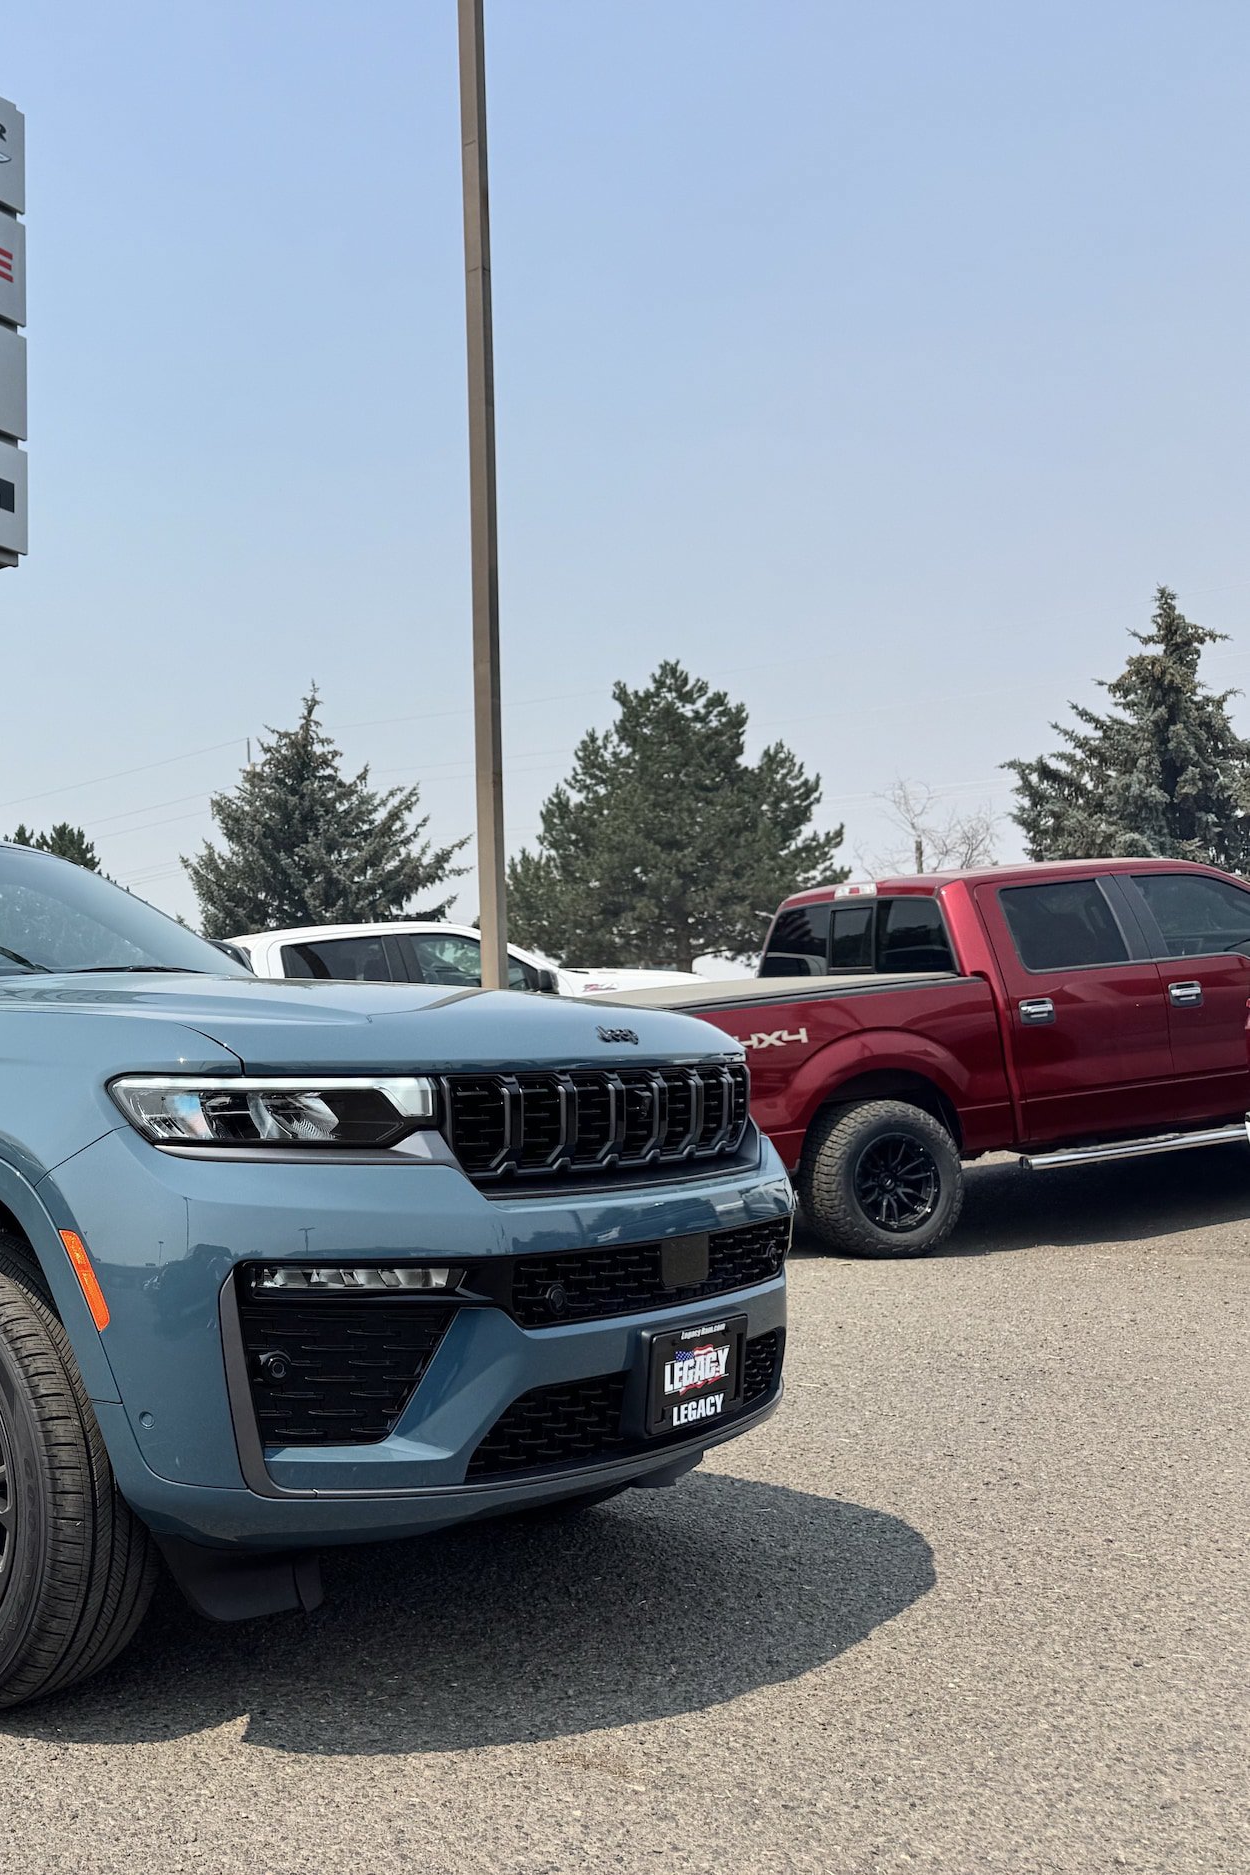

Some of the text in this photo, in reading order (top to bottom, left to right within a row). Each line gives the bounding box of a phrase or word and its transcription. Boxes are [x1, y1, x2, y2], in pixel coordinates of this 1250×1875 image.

[595, 1025, 639, 1045] Jeep
[664, 1347, 730, 1393] LEGACY
[672, 1393, 724, 1426] LEGACY
